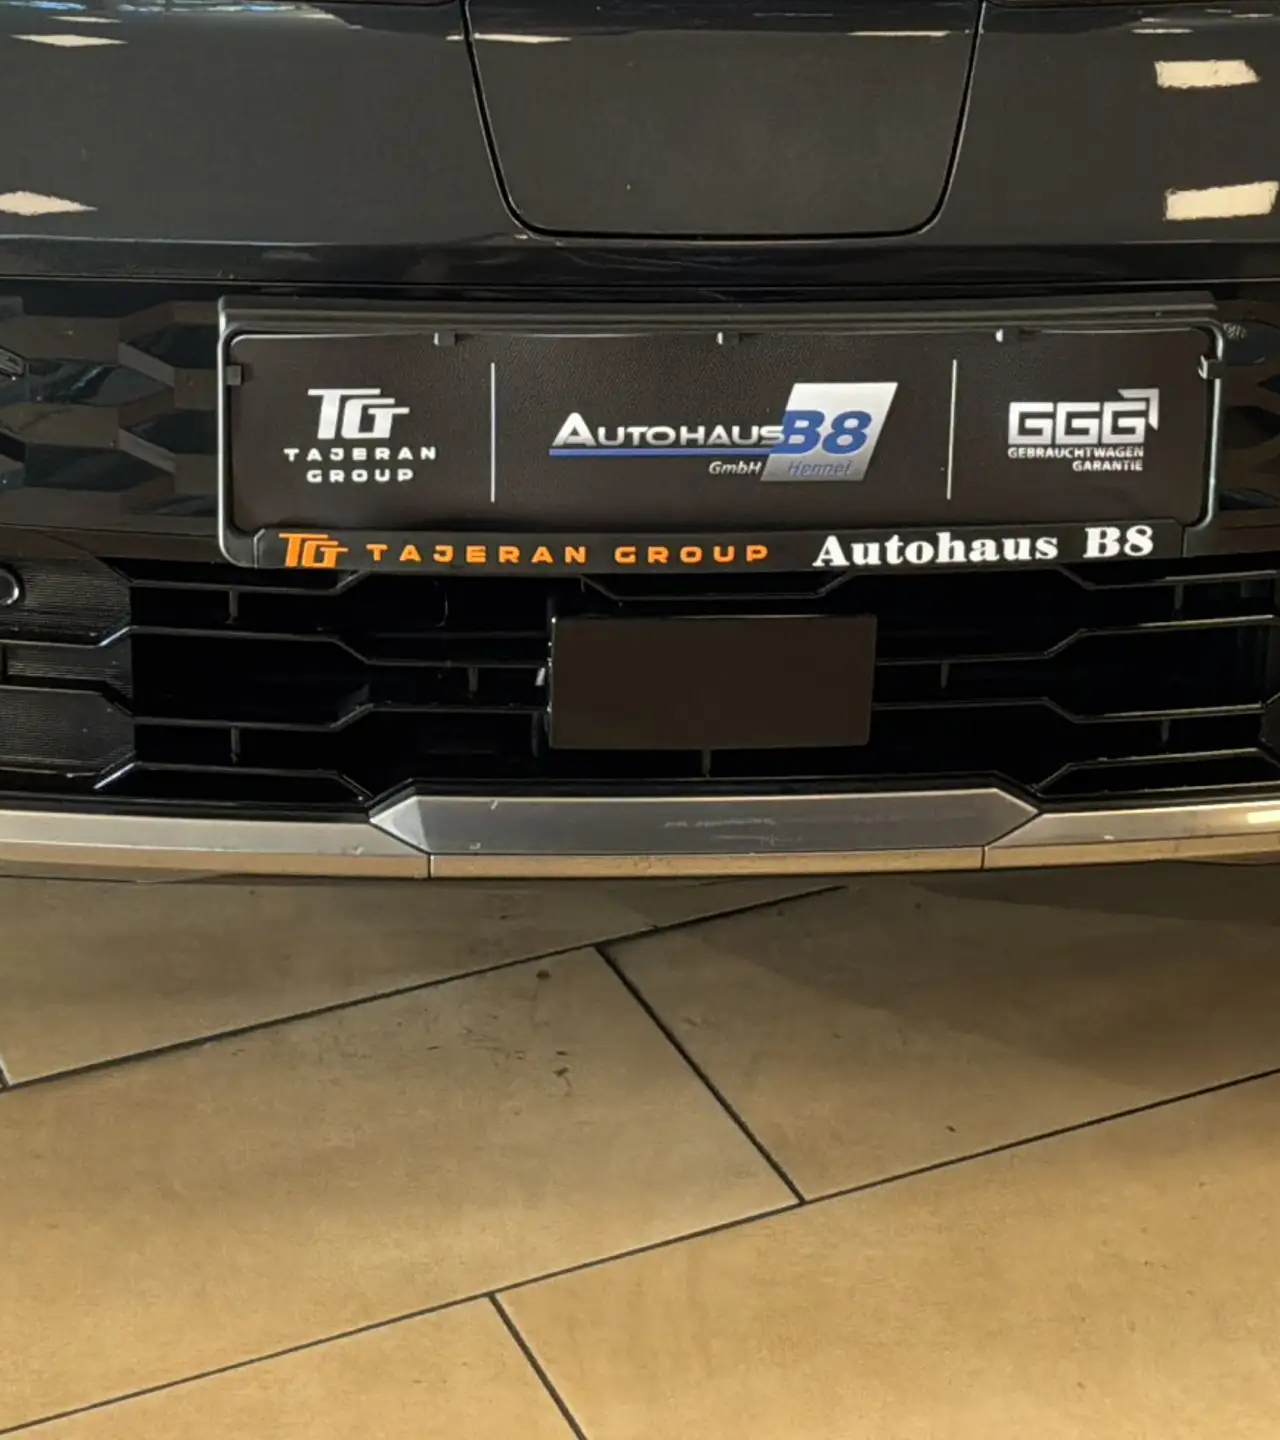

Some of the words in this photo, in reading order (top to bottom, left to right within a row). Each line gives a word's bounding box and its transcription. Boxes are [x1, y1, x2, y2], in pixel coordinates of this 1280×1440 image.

[307, 388, 411, 440] TG
[772, 410, 873, 455] B8
[283, 446, 437, 462] TAJERAN
[1007, 446, 1144, 459] GEBRAUCHTWAGEN
[708, 461, 762, 476] GmbH
[1072, 460, 1143, 472] GARANTIE
[306, 468, 415, 484] GROUP
[278, 533, 349, 569] TG
[366, 543, 588, 564] TAJERAN
[614, 544, 770, 565] GROUP
[812, 531, 1058, 568] Autohaus
[1083, 524, 1153, 559] B8
